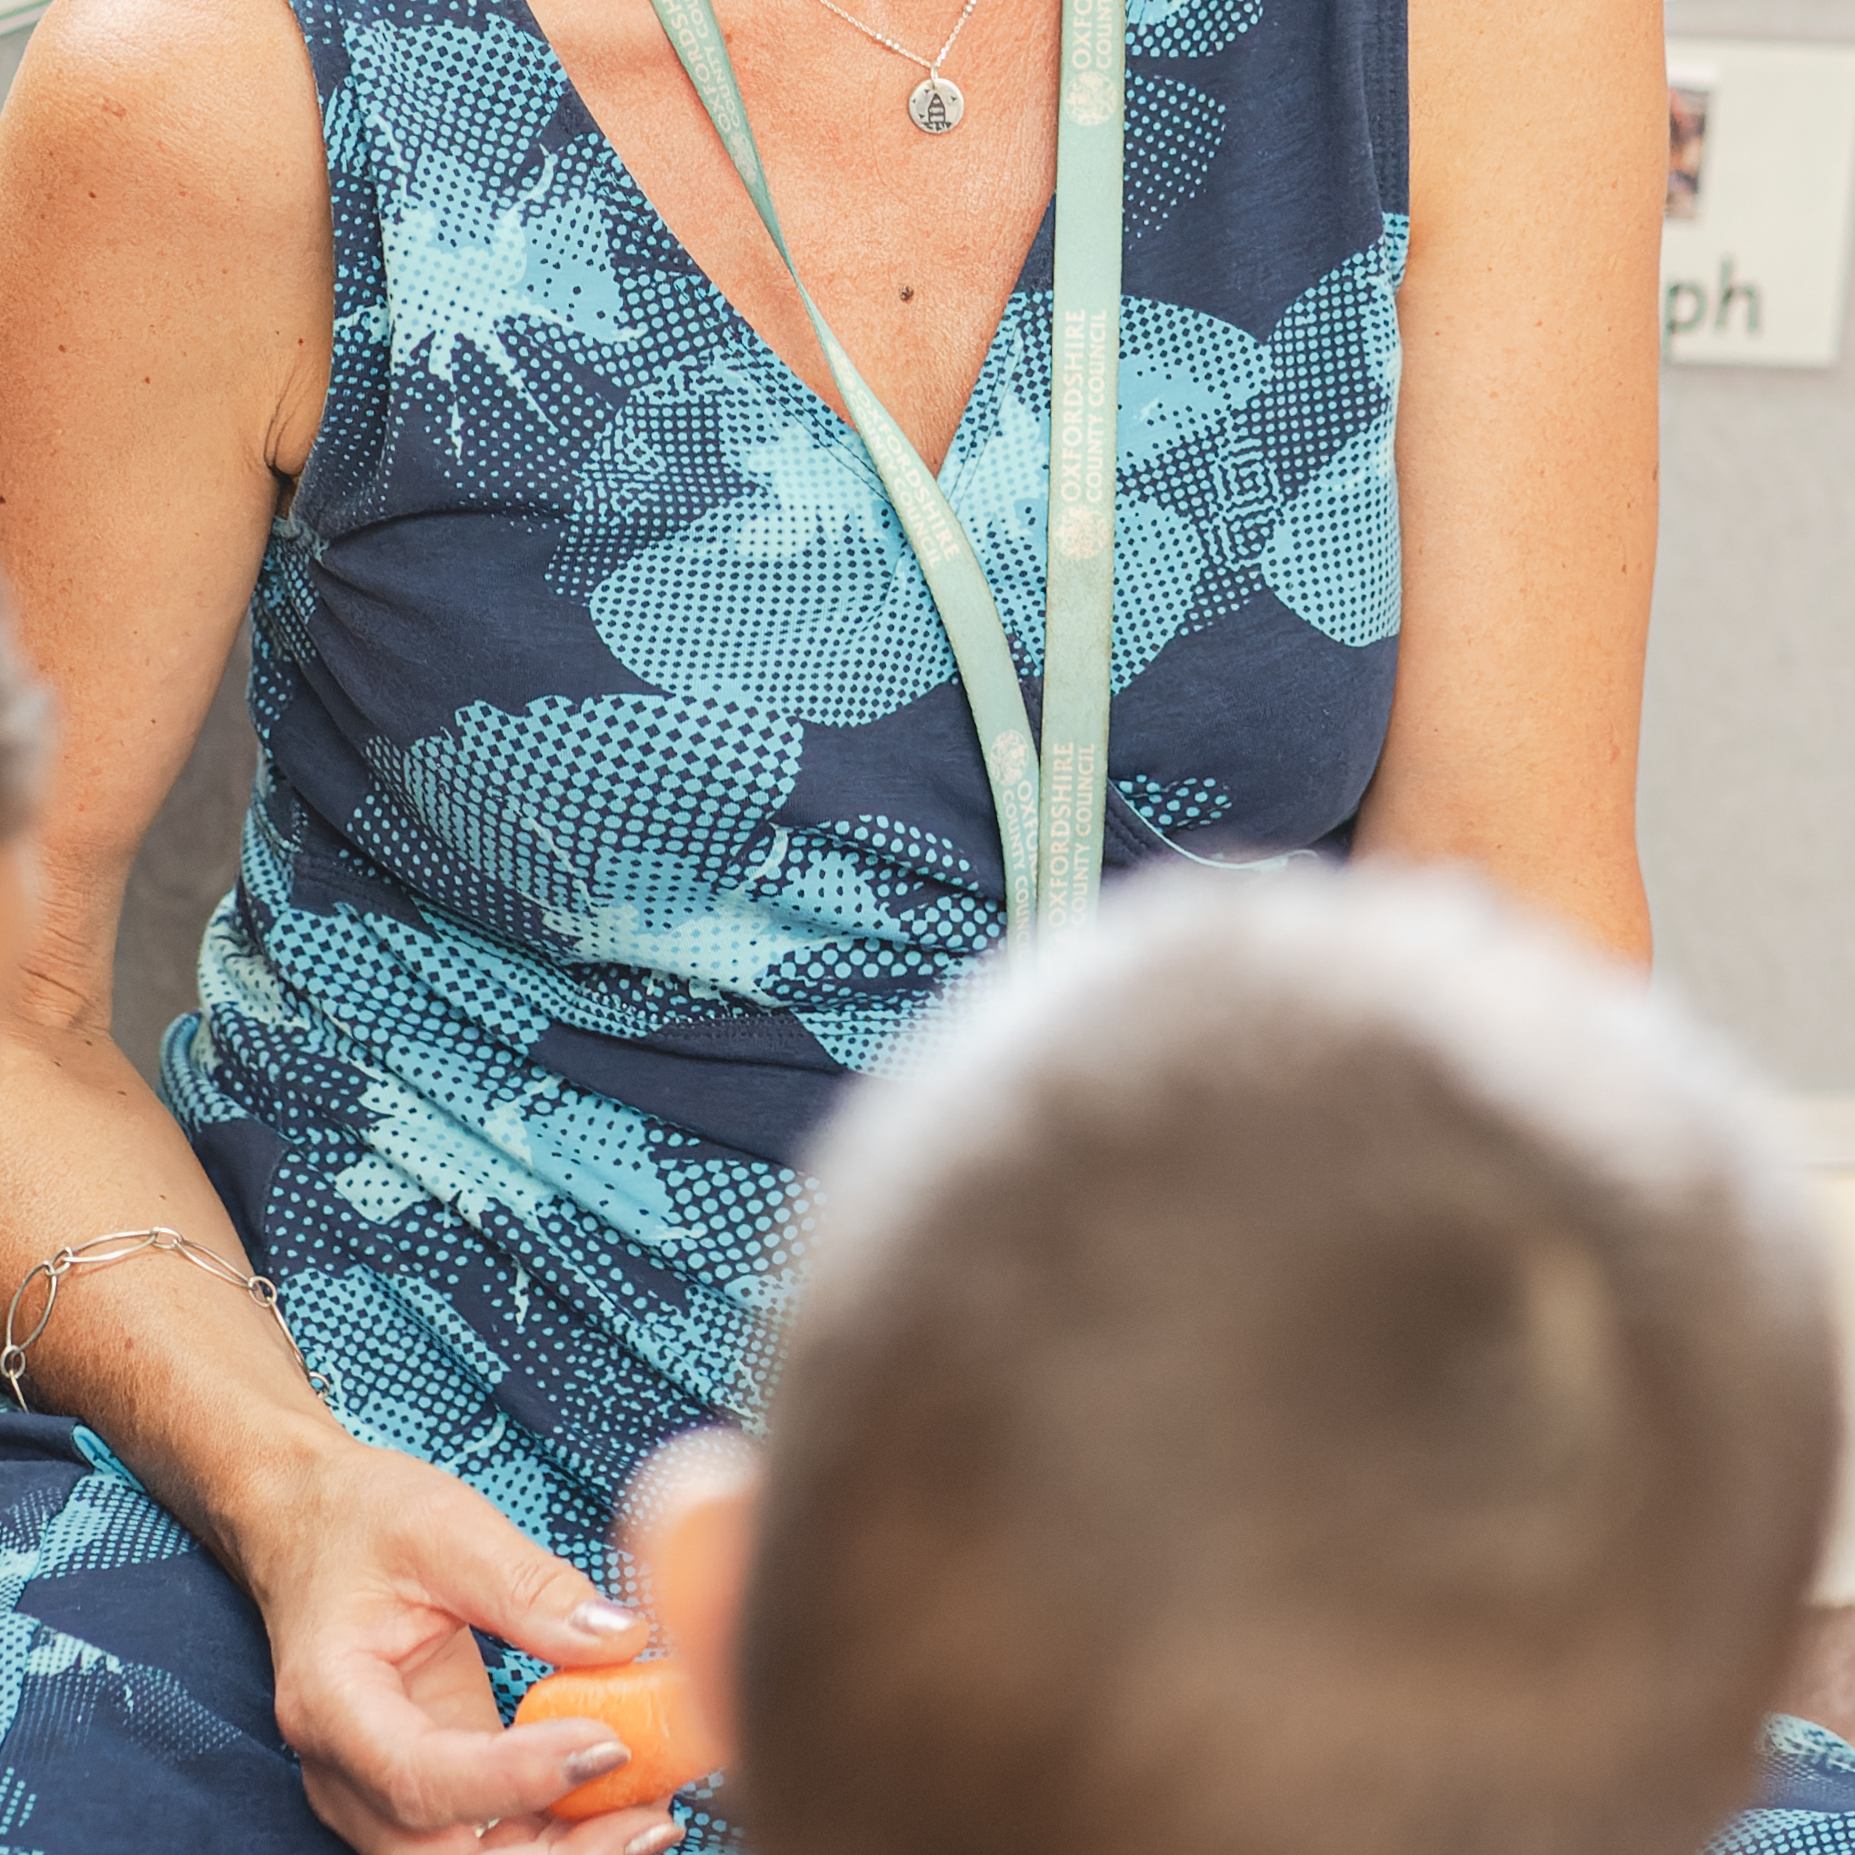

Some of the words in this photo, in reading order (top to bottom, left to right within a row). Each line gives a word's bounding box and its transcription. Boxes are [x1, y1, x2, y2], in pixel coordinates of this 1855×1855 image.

[705, 45, 741, 129] COUNTY
[1060, 308, 1086, 502] OXFORDSHIRE
[1087, 309, 1107, 408] COUNCIL
[849, 393, 898, 473] COUNTY
[892, 476, 942, 570] COUNCIL
[856, 388, 961, 562] OXFORDSHIRE
[1085, 413, 1105, 503] COUNTY
[1002, 789, 1027, 872] COUNTY
[1047, 741, 1075, 929] OXFORDSHIRE
[1075, 743, 1096, 837] COUNCIL
